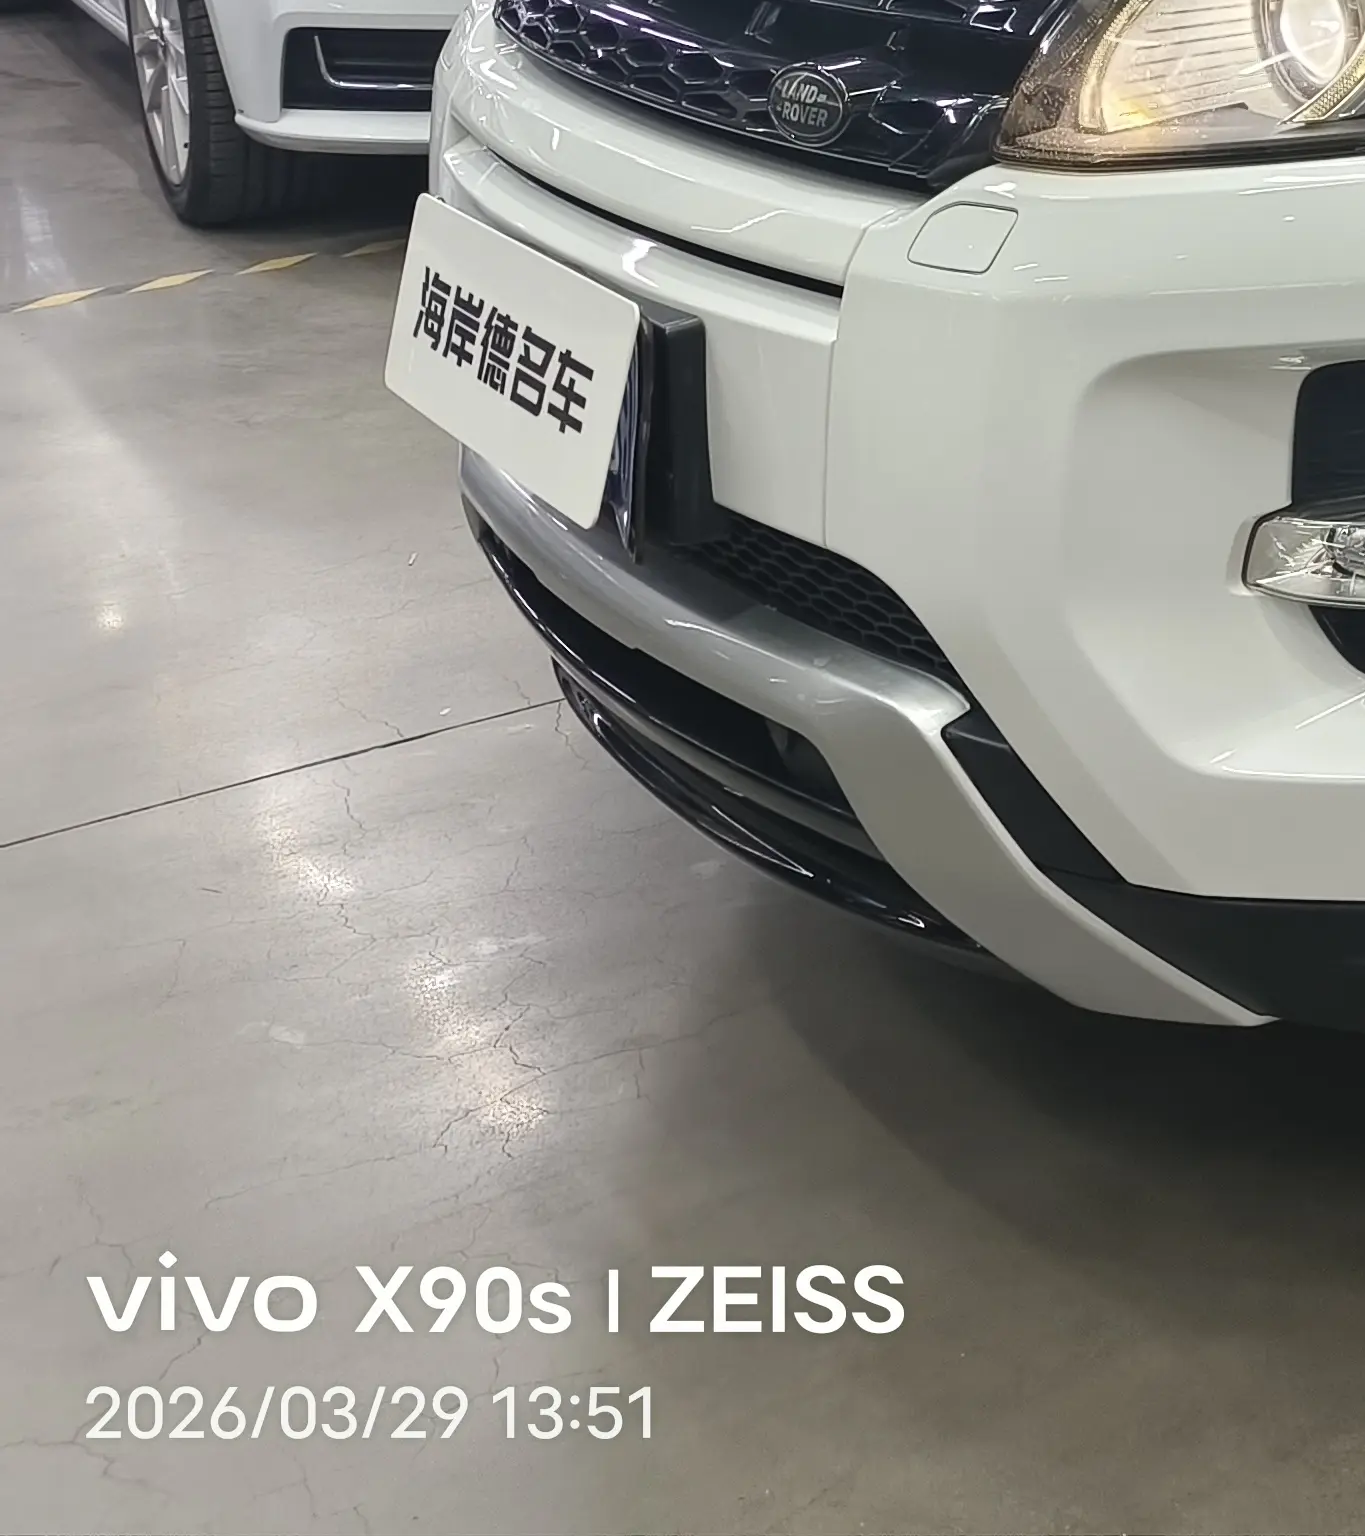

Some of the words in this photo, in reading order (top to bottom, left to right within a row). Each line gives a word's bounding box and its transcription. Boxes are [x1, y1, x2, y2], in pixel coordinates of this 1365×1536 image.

[780, 79, 819, 104] LAND
[781, 101, 829, 128] ROVER
[413, 266, 595, 434] 海岸德名车
